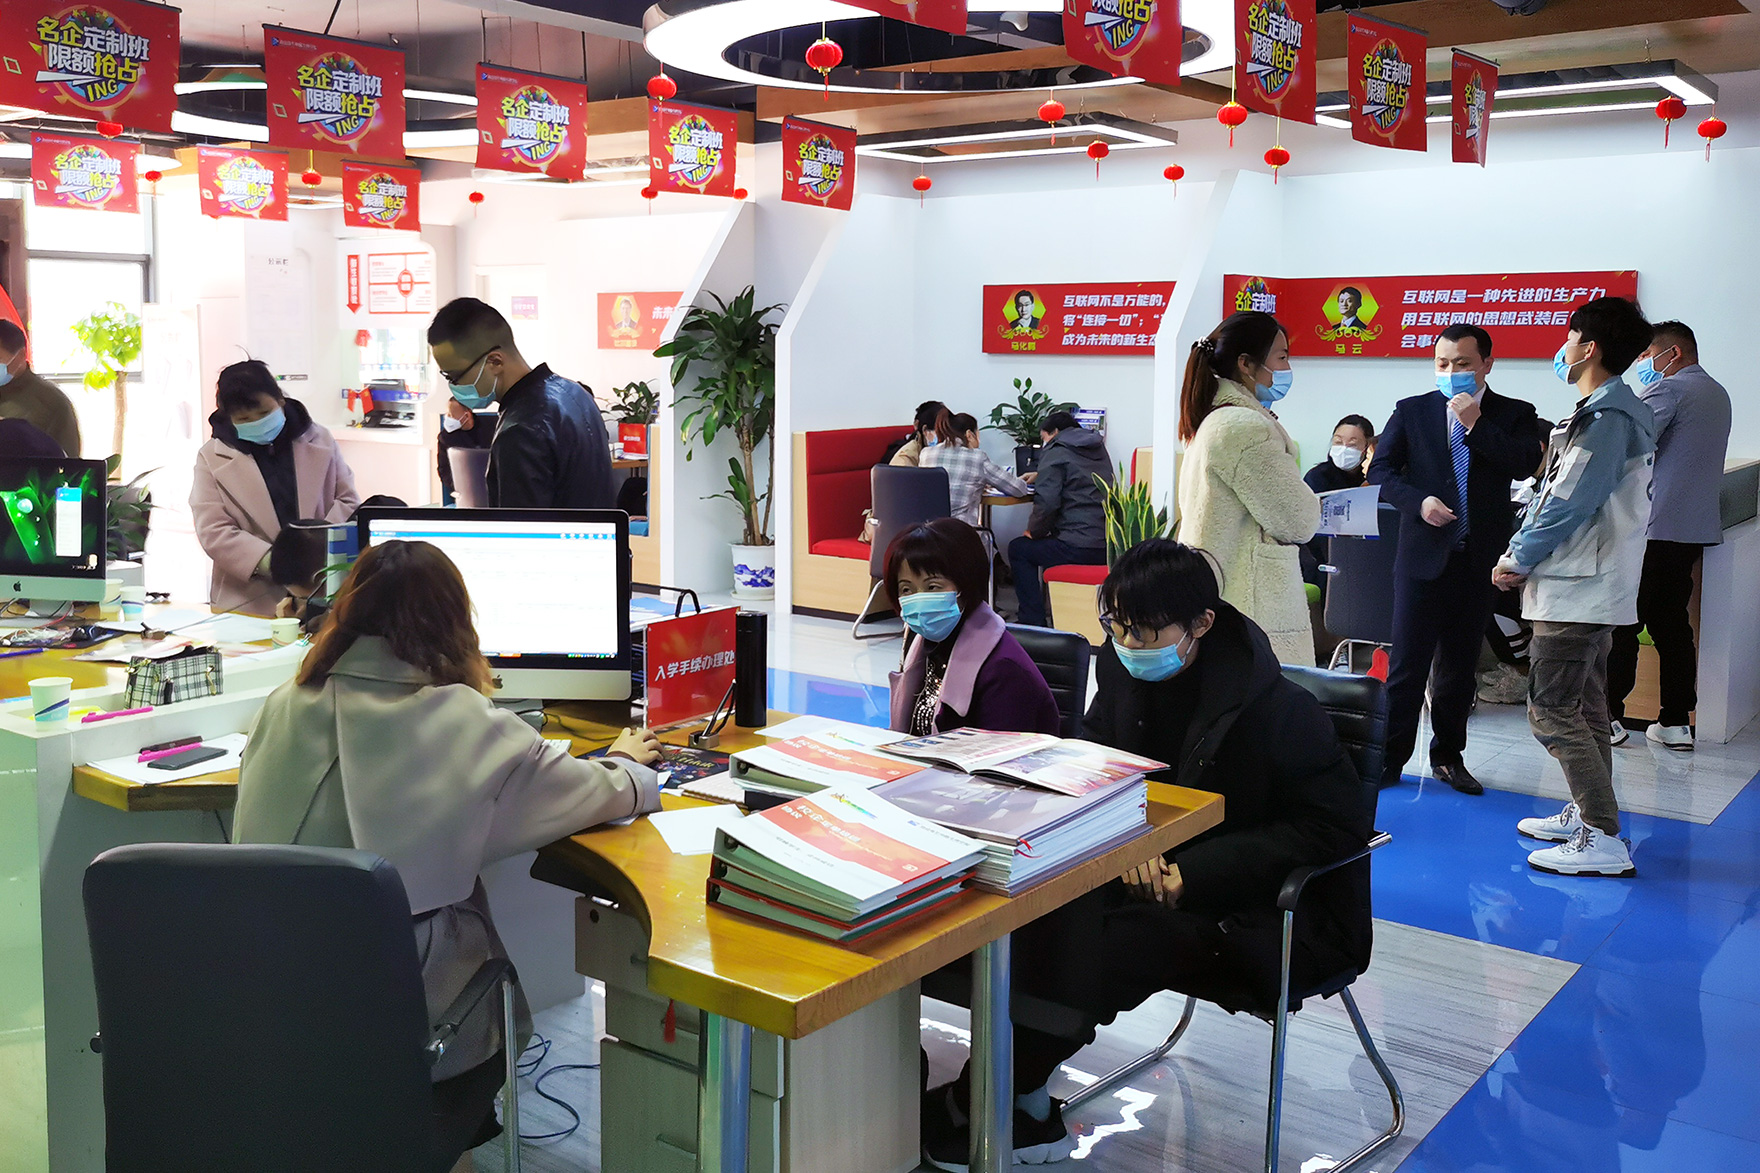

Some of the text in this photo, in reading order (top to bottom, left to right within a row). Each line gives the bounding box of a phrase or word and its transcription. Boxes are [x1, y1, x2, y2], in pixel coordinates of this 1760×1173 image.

[1112, 19, 1134, 50] ING
[1248, 3, 1303, 48] 名企定制班
[37, 16, 150, 61] 名企定制班
[48, 43, 139, 82] 限额抢占
[1251, 31, 1295, 72] 限额抢占
[297, 65, 383, 97] 名企定制班
[1266, 69, 1283, 94] ING
[1363, 53, 1412, 86] 名企定制班
[86, 79, 118, 102] ING
[306, 88, 375, 117] 限额抢占
[1366, 78, 1407, 108] 限额抢占
[501, 97, 570, 125] 名企定制班
[1380, 106, 1396, 130] ING
[335, 115, 359, 137] ING
[507, 117, 564, 143] 限额抢占
[668, 125, 723, 149] 名企定制班
[530, 141, 551, 161] ING
[799, 143, 844, 166] 名企定制班
[54, 154, 121, 175] 名企定制班
[691, 164, 707, 183] ING
[85, 187, 103, 202] ING
[358, 180, 408, 198] 名企定制班
[817, 179, 830, 195] ING
[1062, 294, 1166, 307] 互联网不是万能的，
[1235, 290, 1277, 314] 名企定制班
[1401, 286, 1606, 304] 互联网是一种先进的生产力
[1401, 311, 1575, 327] 用互联网的思想武装后
[1400, 334, 1438, 349] 会事
[654, 650, 736, 682] 入学手续办理处
